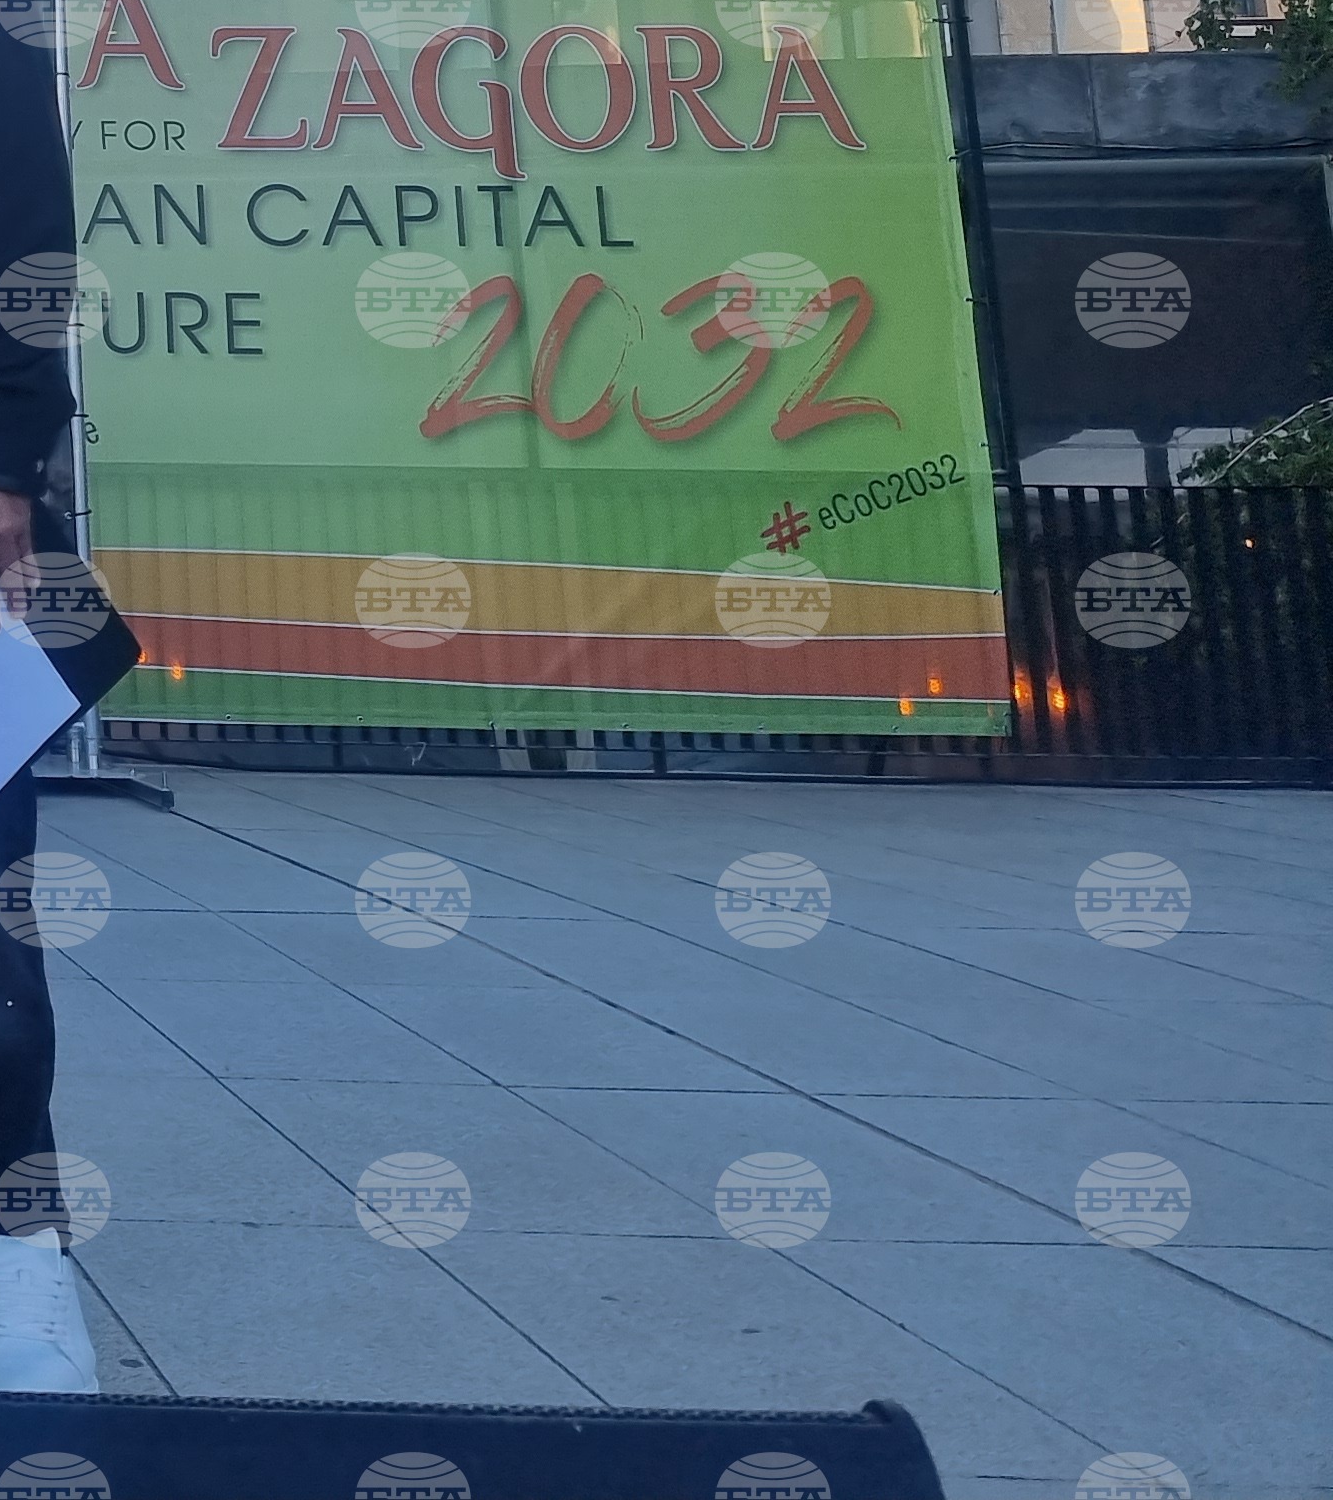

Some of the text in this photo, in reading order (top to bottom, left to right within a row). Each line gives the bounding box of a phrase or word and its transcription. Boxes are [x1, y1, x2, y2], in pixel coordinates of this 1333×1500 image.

[100, 120, 186, 150] FOR
[209, 25, 867, 181] ZAGORA
[246, 183, 634, 249] CAPITAL
[419, 272, 902, 442] 2032
